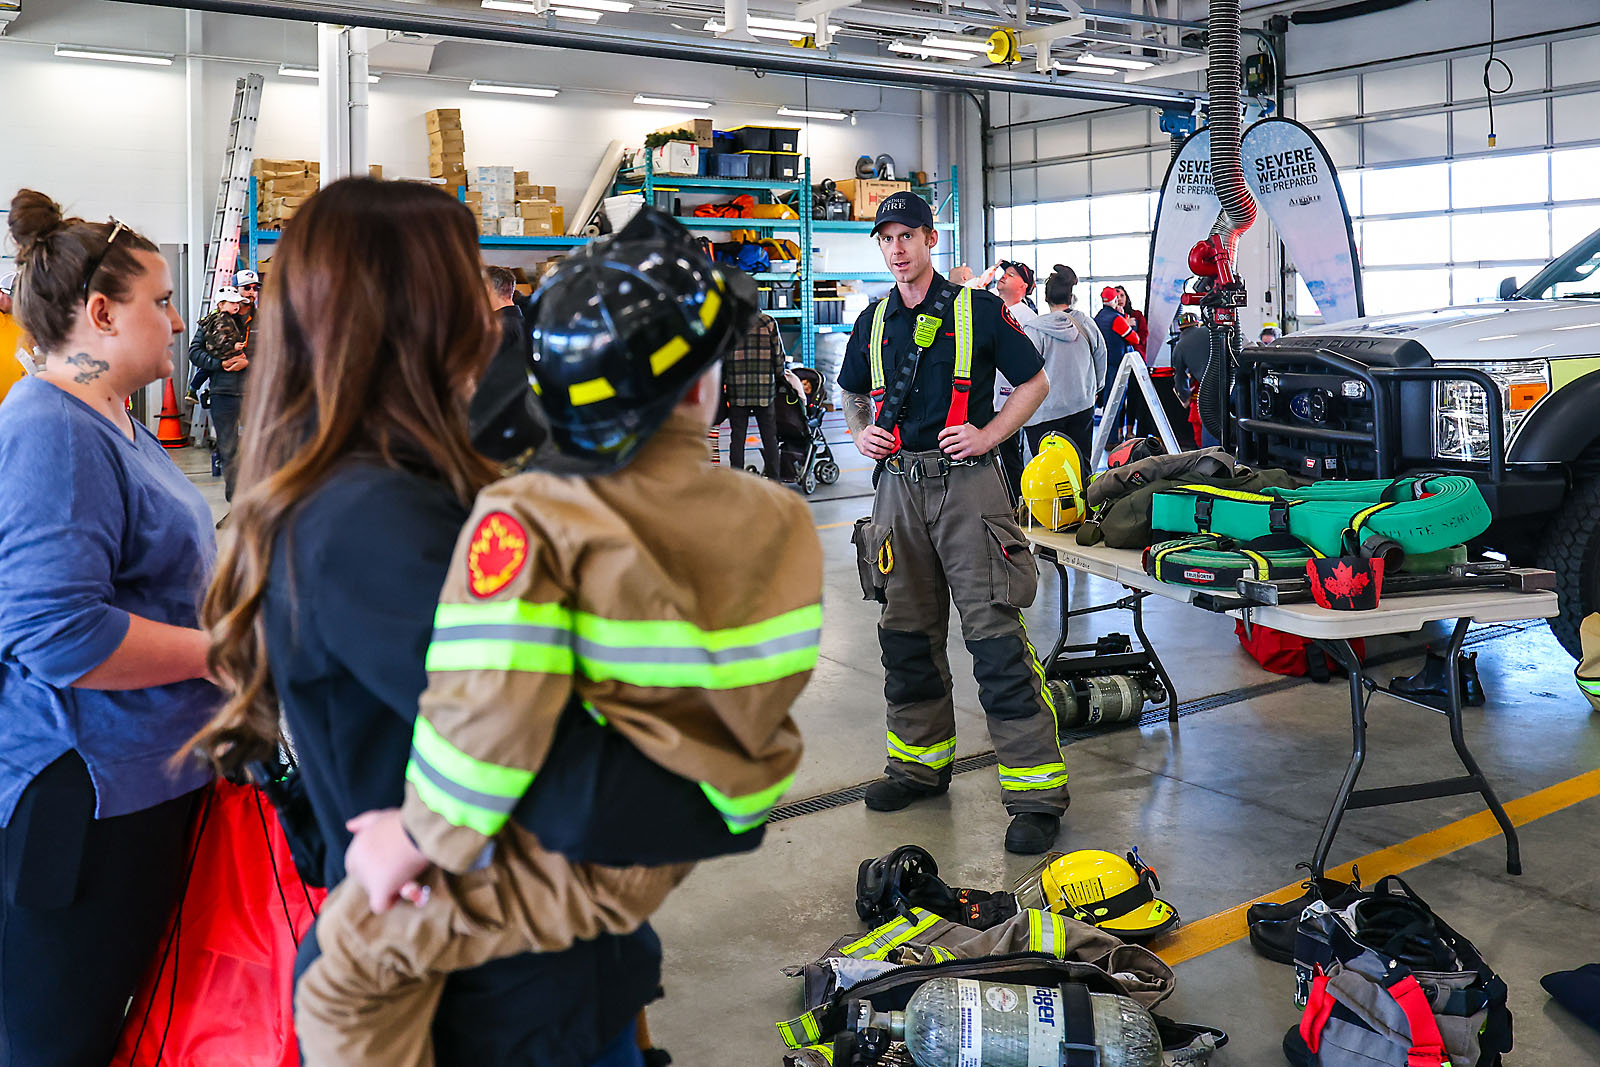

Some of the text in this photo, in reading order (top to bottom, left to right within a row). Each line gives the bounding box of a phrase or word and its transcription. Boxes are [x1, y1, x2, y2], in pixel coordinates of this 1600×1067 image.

[1255, 147, 1314, 171] SEVERE
[1179, 160, 1210, 173] SEVE
[1257, 162, 1317, 183] WEATHER
[1178, 174, 1212, 185] WEATH
[1259, 175, 1318, 195] BE PREPARED
[1177, 185, 1185, 194] BE
[881, 202, 906, 214] FIRE
[1326, 340, 1381, 349] DUTY
[1032, 986, 1058, 1027] räger
